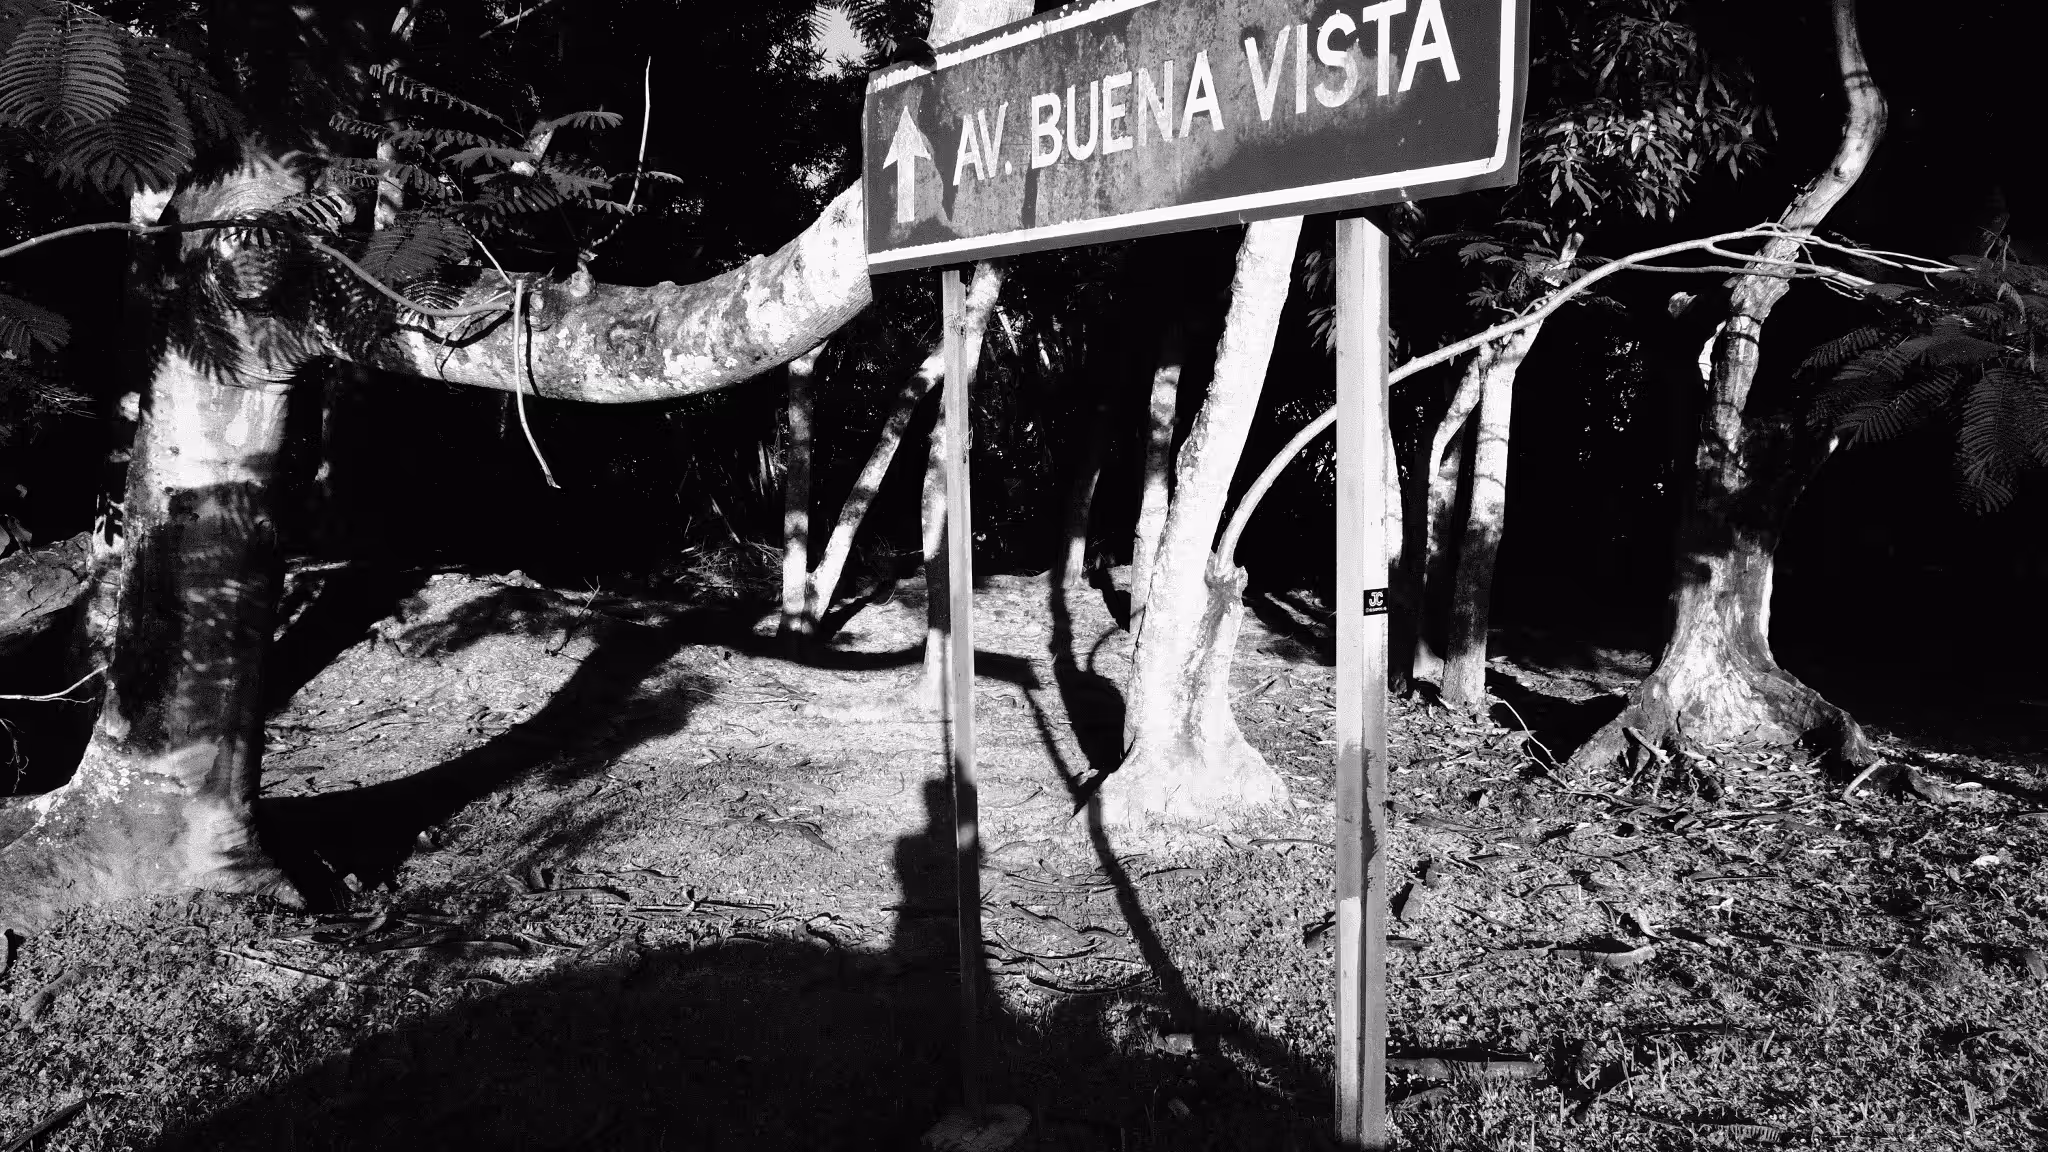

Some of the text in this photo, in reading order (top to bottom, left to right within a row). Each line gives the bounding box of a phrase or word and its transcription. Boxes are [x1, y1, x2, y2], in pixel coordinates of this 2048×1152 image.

[952, 0, 1461, 186] AV. BUENA VISTA
[1369, 591, 1383, 606] JC
